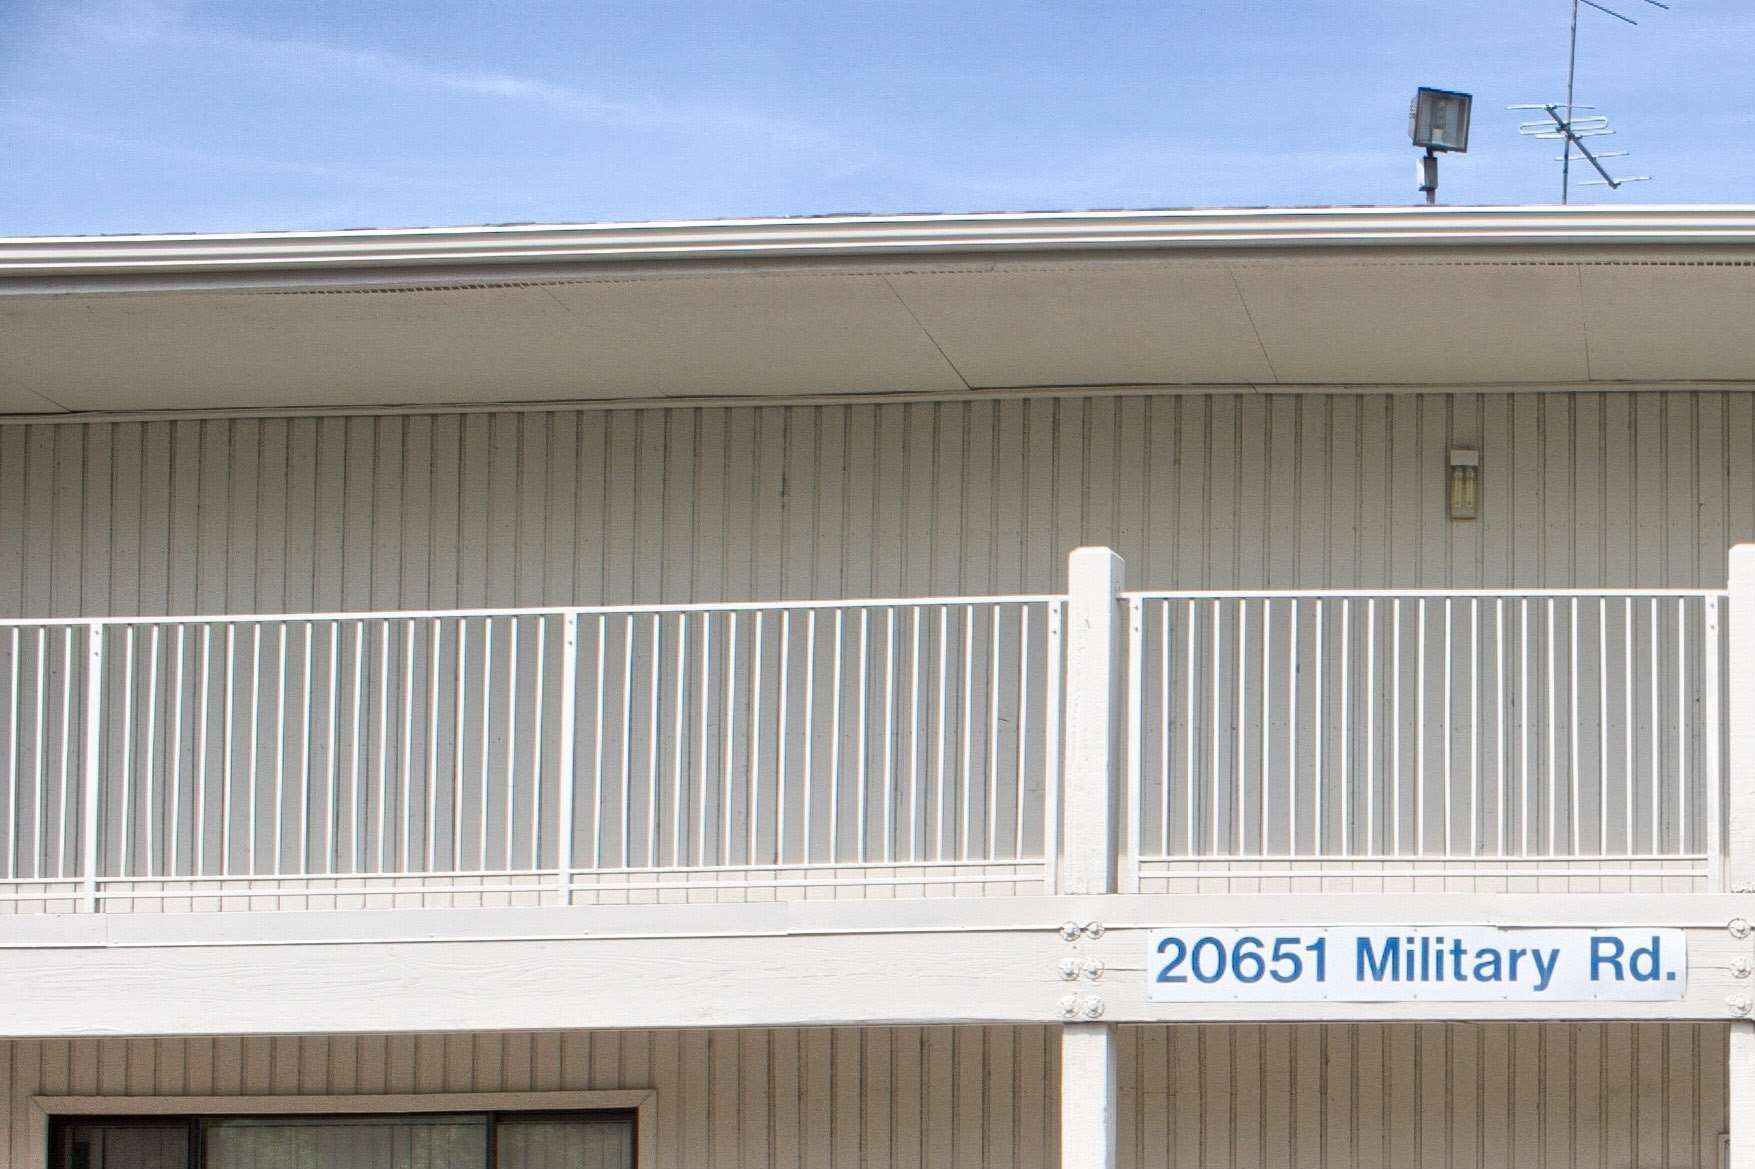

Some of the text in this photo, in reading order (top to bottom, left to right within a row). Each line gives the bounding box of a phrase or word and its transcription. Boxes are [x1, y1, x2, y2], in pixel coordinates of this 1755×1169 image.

[1155, 935, 1677, 992] 20651 Military Rd.
